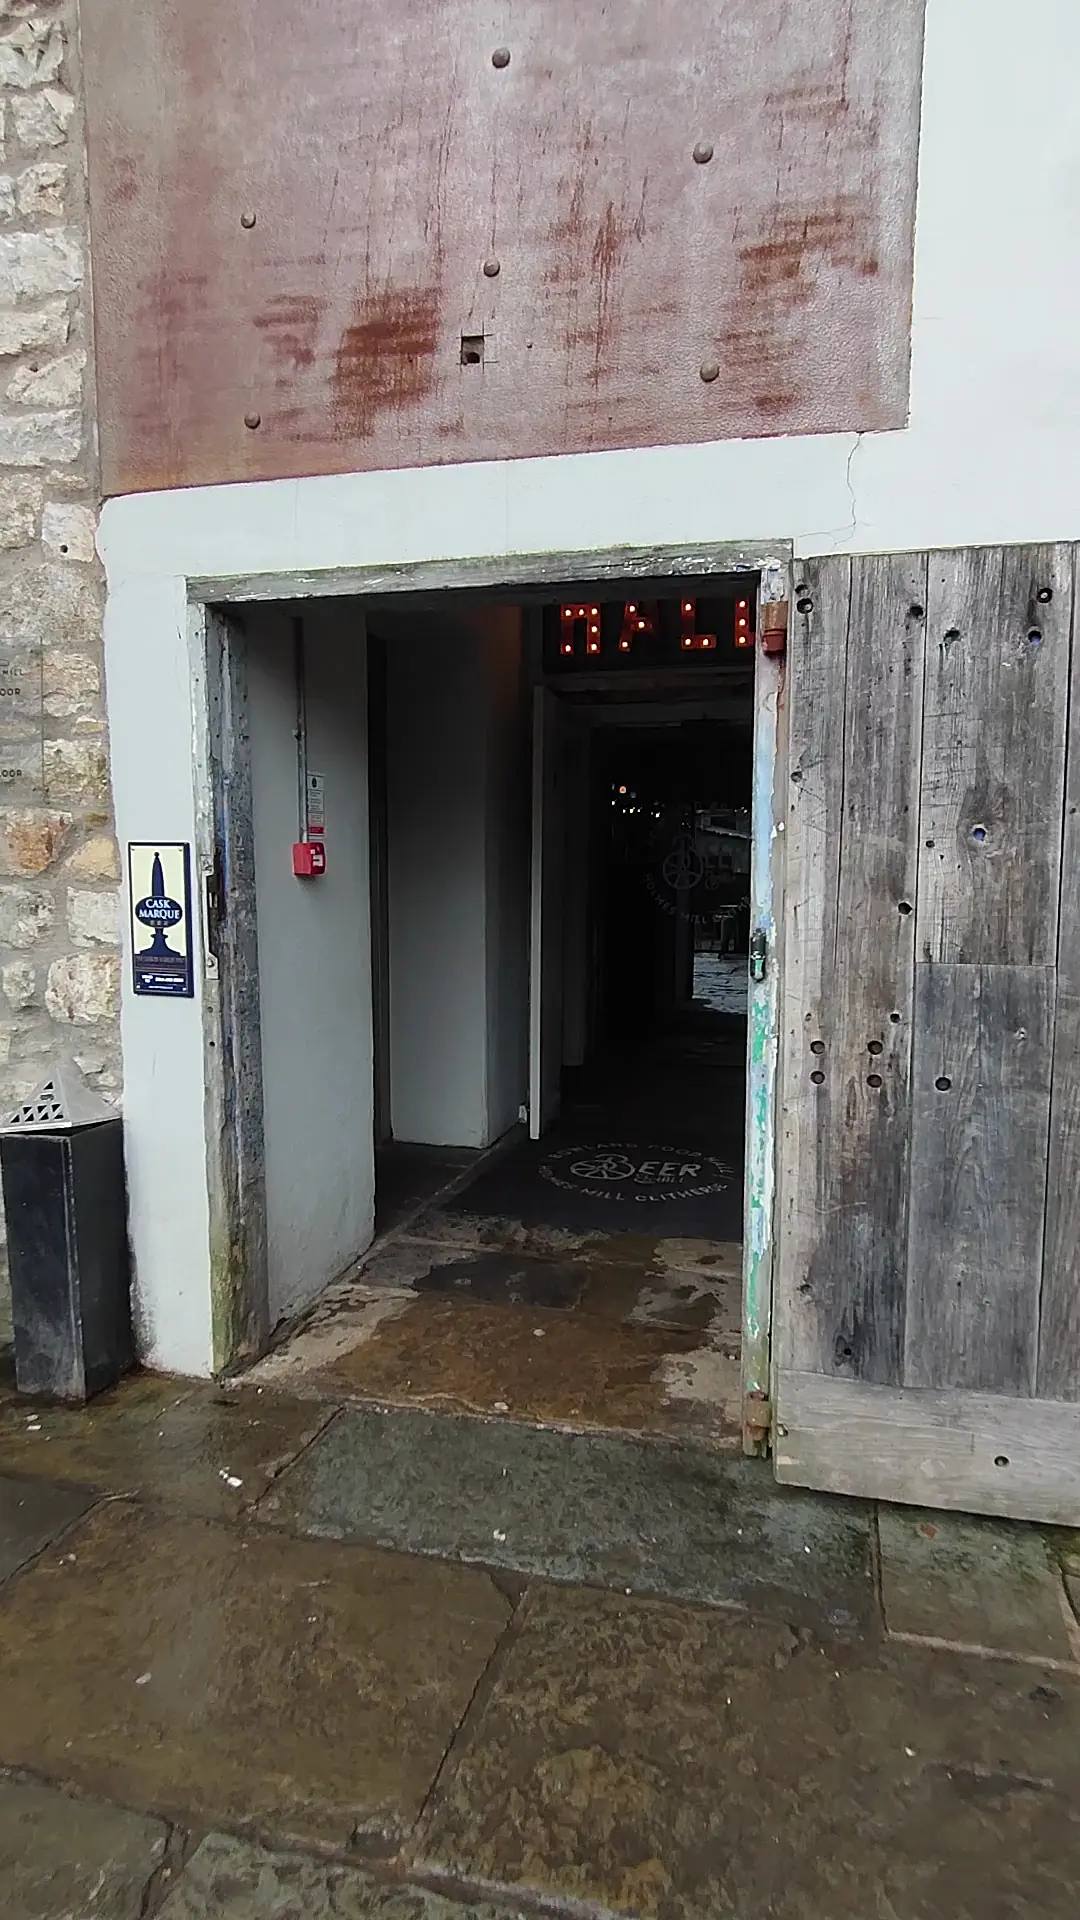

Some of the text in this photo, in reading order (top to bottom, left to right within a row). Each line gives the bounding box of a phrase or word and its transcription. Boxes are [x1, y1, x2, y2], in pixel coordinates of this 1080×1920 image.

[0, 769, 22, 778] OOR
[145, 899, 171, 909] CASK
[138, 909, 180, 920] MARQUE
